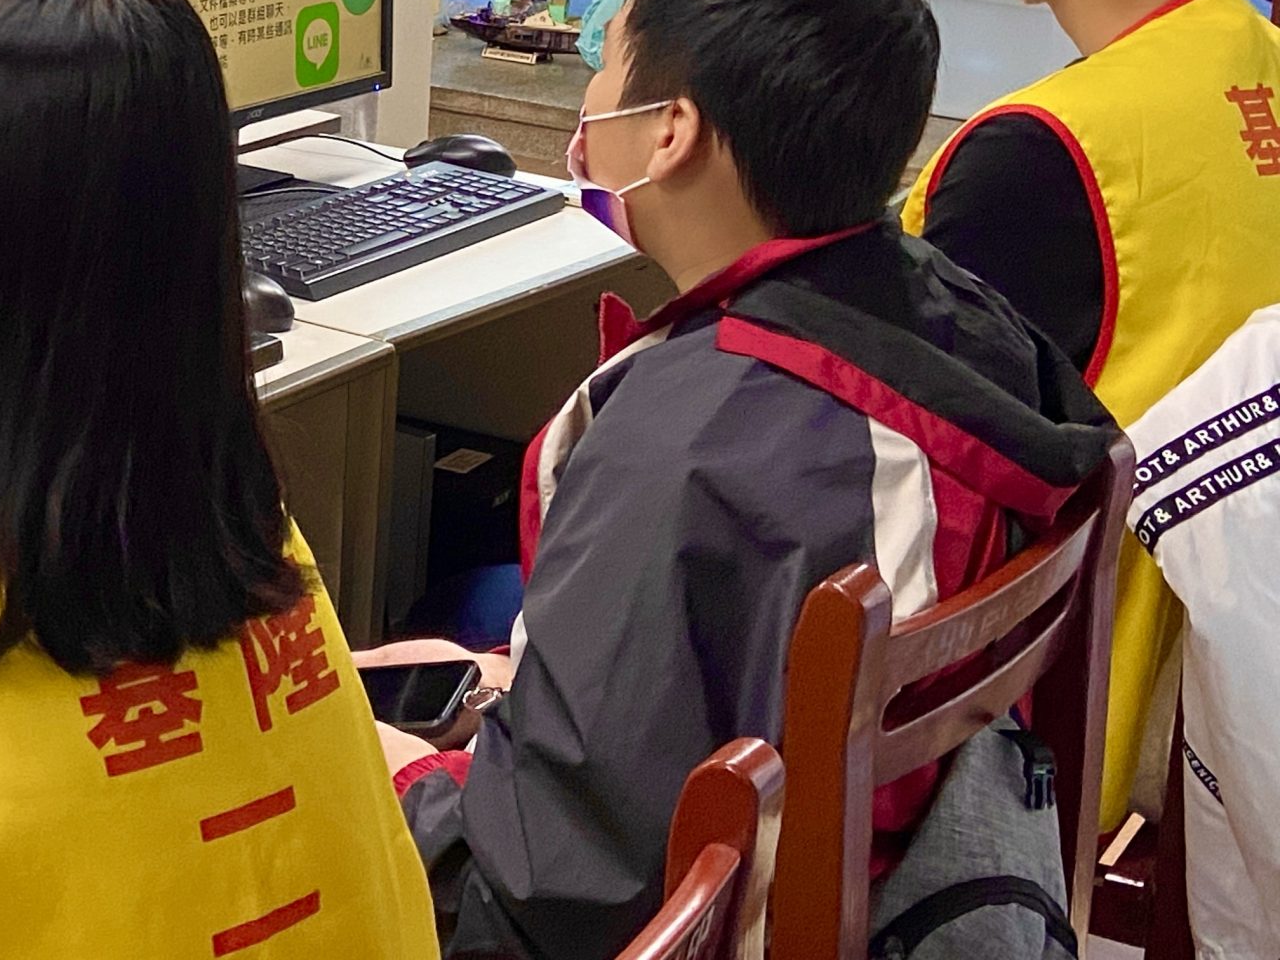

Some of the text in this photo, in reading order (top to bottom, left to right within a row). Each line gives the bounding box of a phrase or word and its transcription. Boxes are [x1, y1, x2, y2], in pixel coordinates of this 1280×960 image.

[307, 33, 328, 50] LINE
[1132, 449, 1180, 489] OT&
[79, 593, 341, 778] 基隆
